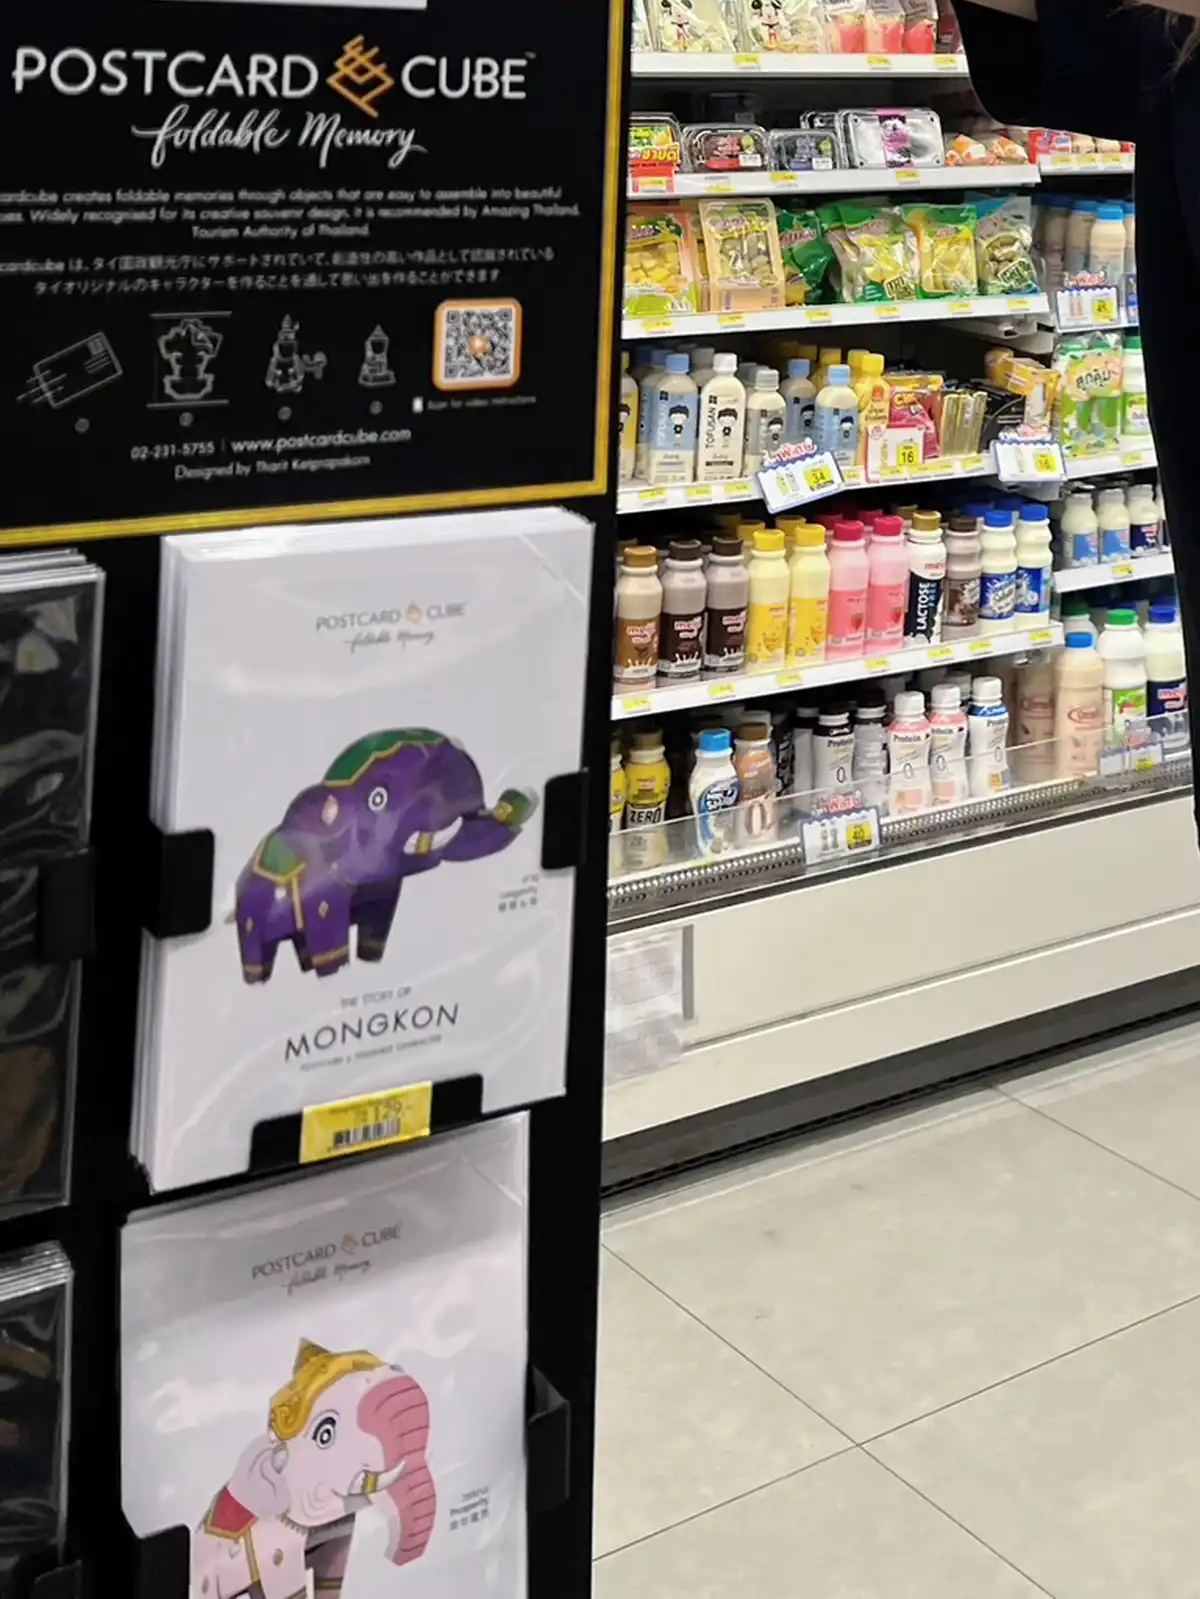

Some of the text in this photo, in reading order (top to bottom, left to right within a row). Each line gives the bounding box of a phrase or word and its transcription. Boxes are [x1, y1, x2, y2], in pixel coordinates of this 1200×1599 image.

[12, 46, 528, 100] POSTCARD CUBE
[131, 104, 429, 168] foldable Memory
[115, 188, 170, 203] foldable
[238, 188, 287, 204] through
[336, 188, 362, 201] that
[363, 190, 384, 201] are
[419, 188, 432, 200] to
[29, 208, 80, 225] Widely
[159, 207, 178, 222] for
[378, 204, 460, 218] recommended
[463, 203, 478, 220] by
[481, 204, 530, 220] Amazing
[192, 226, 239, 239] Tourism
[243, 224, 298, 240] Authority
[301, 224, 316, 238] of
[130, 427, 412, 460] 02-231-5755 www.postcardcube.com
[902, 451, 914, 464] 16
[174, 462, 234, 481] Designed
[235, 461, 251, 477] by
[916, 582, 930, 630] LACTOSE
[316, 608, 402, 632] POSTCARD
[630, 808, 662, 824] ZERO
[284, 1002, 459, 1063] MONGKON
[252, 1222, 402, 1279] POSTCARD CUBE
